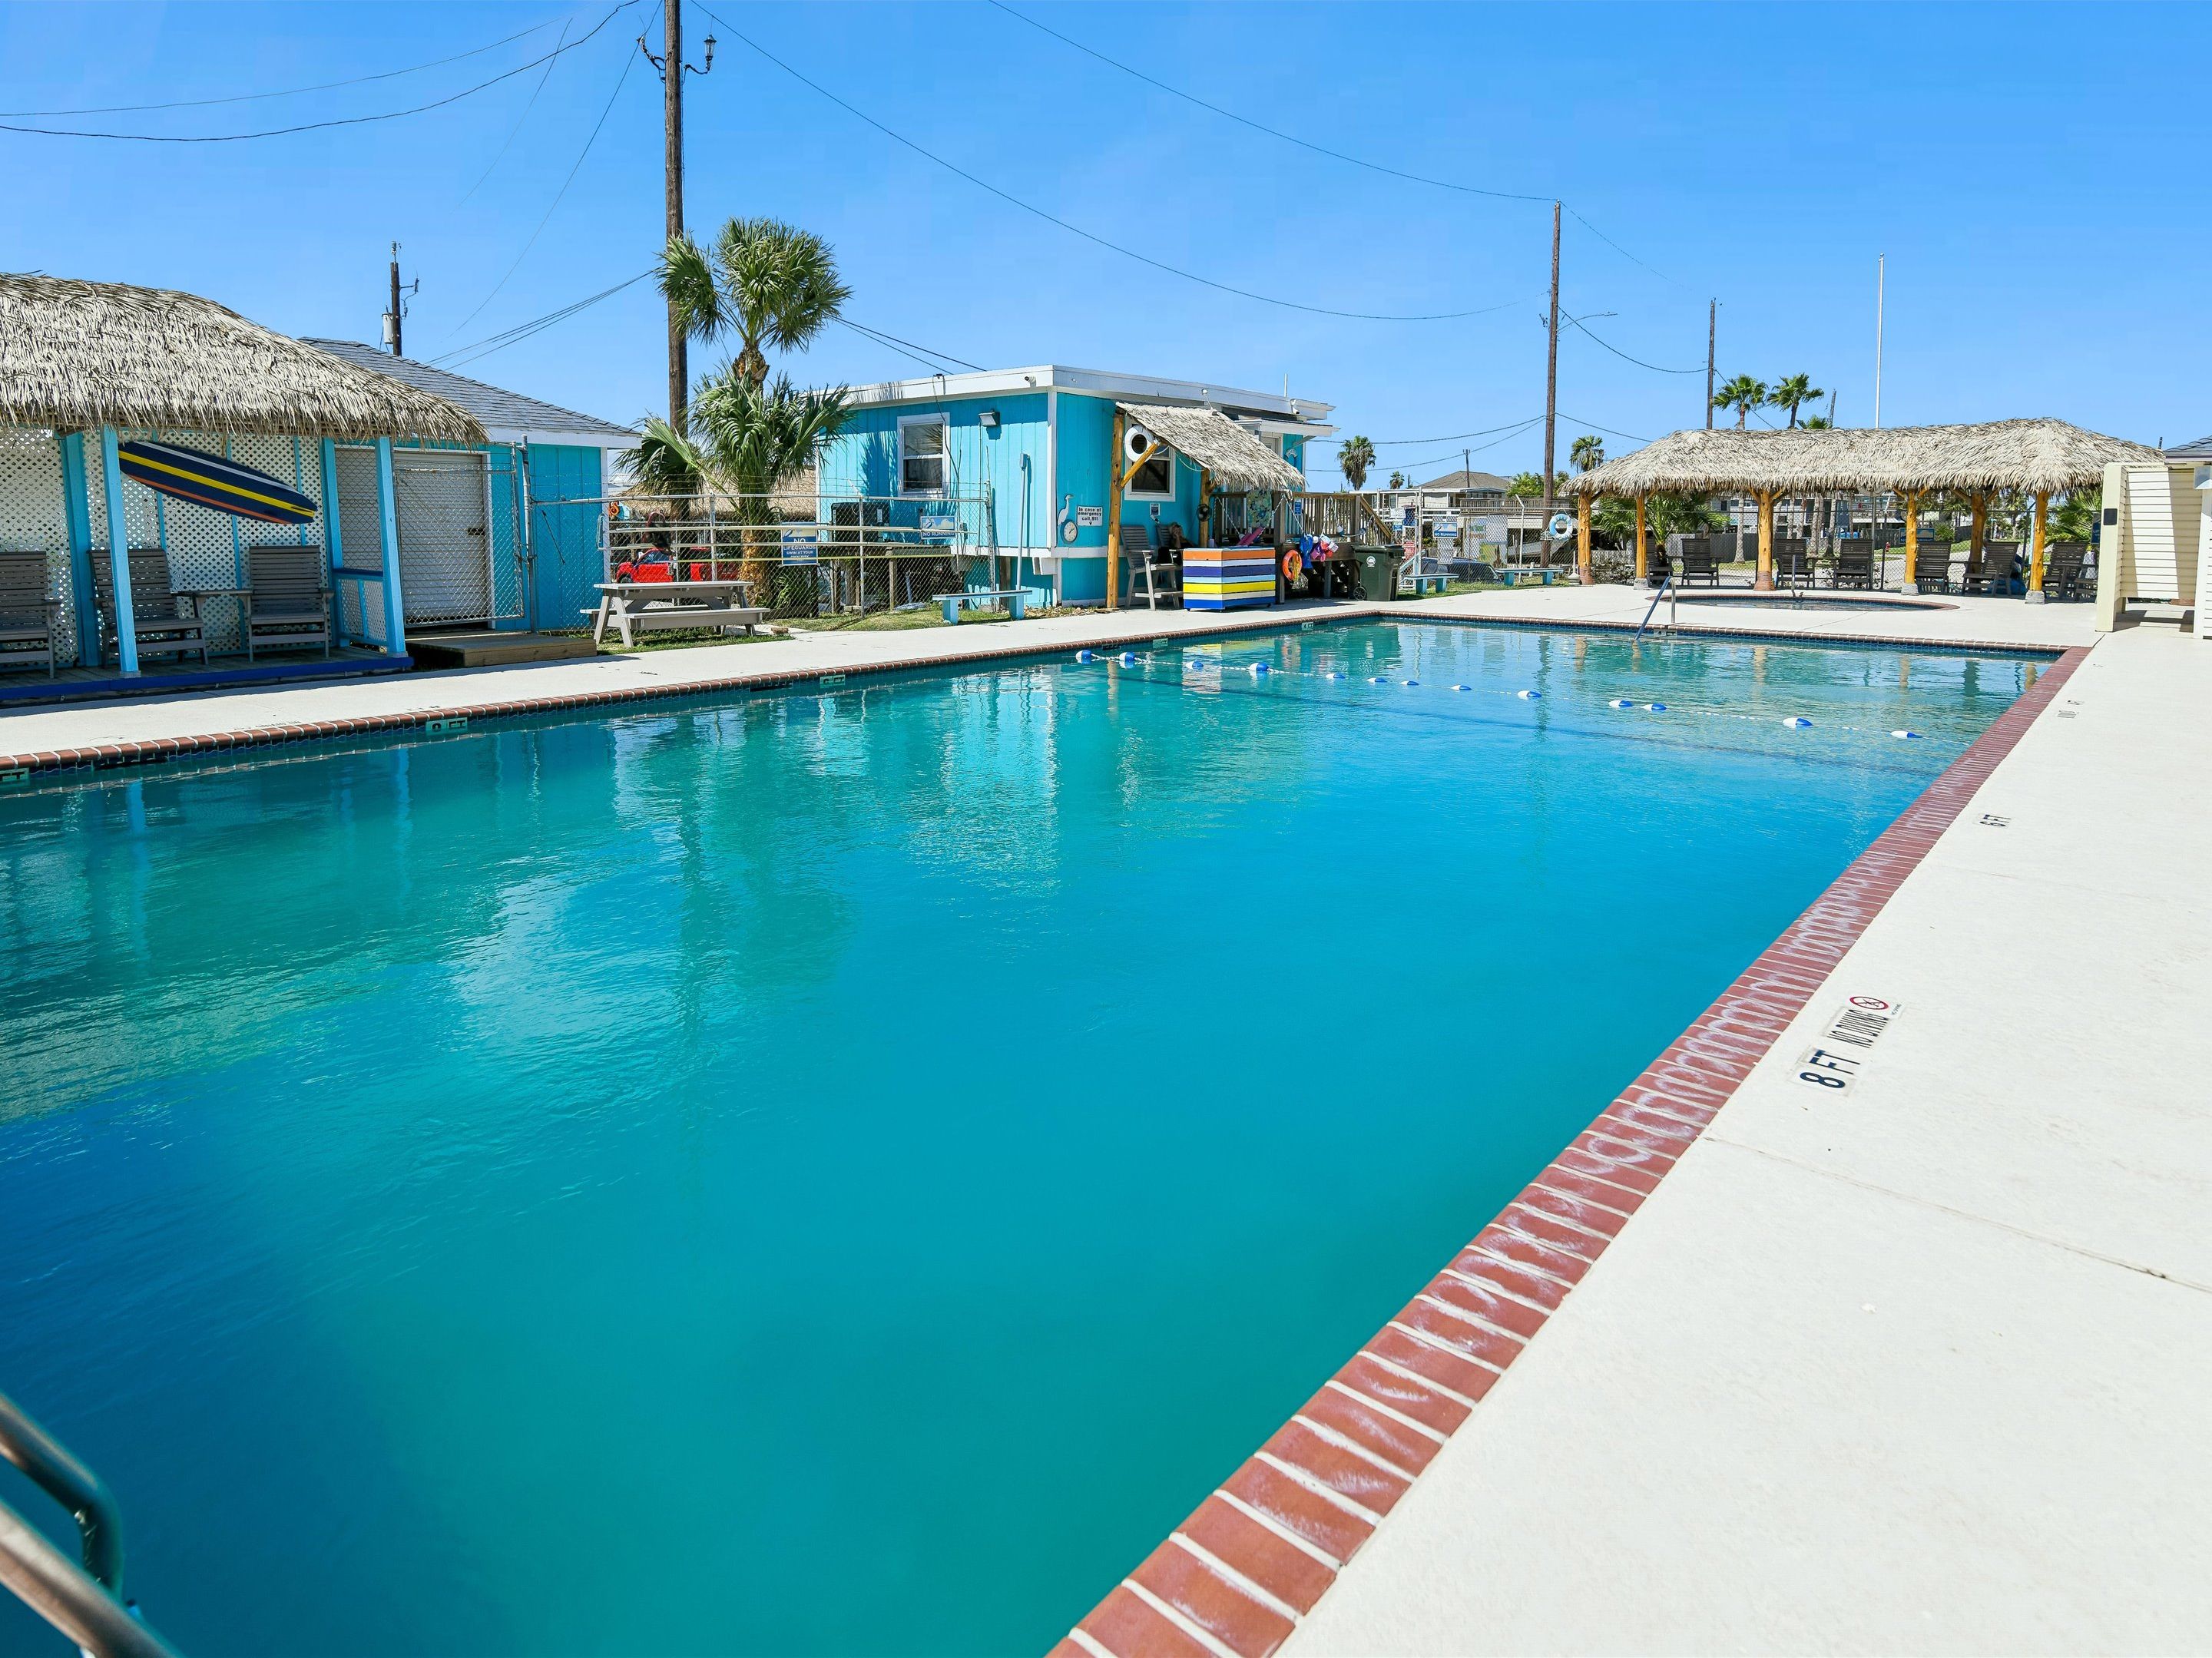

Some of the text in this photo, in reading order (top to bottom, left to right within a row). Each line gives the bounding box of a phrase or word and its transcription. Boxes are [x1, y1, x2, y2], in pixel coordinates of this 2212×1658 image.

[1983, 814, 2012, 823] FT
[1800, 1008, 1889, 1088] 8 FT NO DIVING
